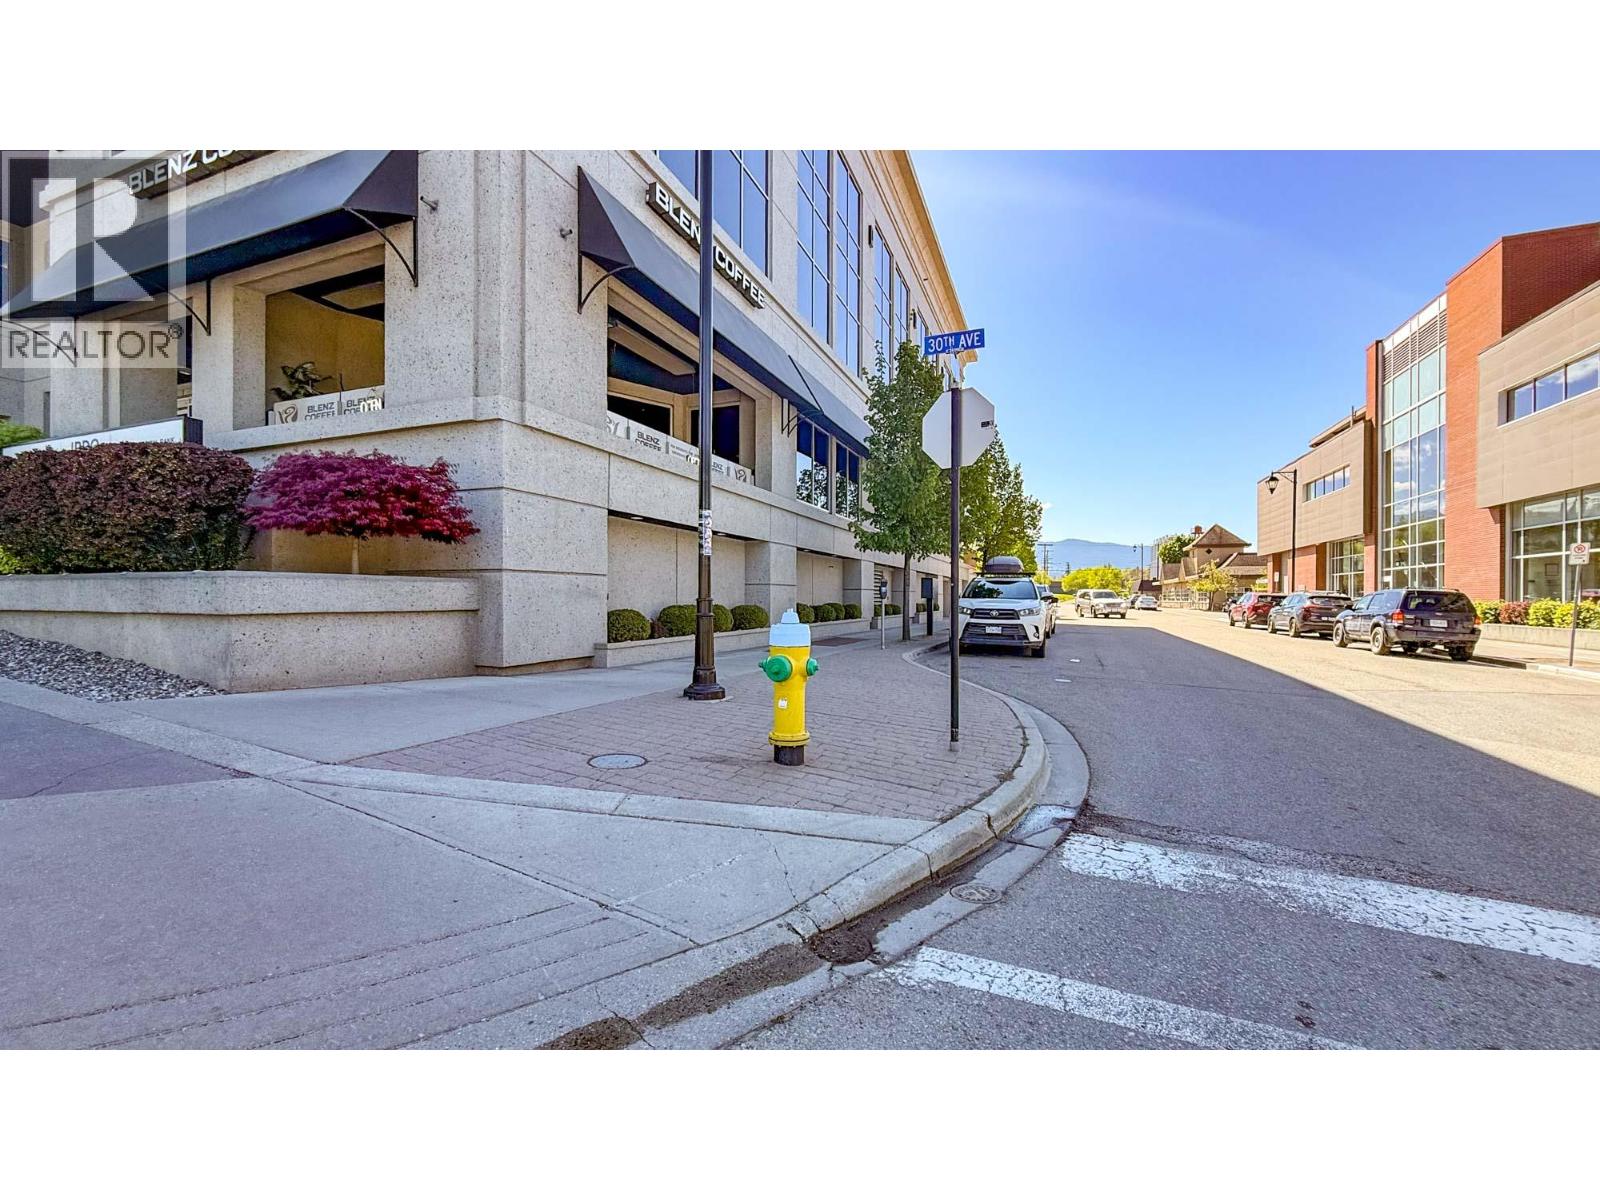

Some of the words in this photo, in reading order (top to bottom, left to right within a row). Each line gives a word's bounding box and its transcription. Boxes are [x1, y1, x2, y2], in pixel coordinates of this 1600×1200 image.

[128, 150, 197, 194] BLENZ
[655, 182, 701, 245] BLEN
[715, 245, 765, 309] COFFEE
[928, 335, 955, 352] 30TH
[959, 332, 981, 348] AVE
[307, 402, 335, 414] BLENZ
[637, 431, 660, 446] BLENZ
